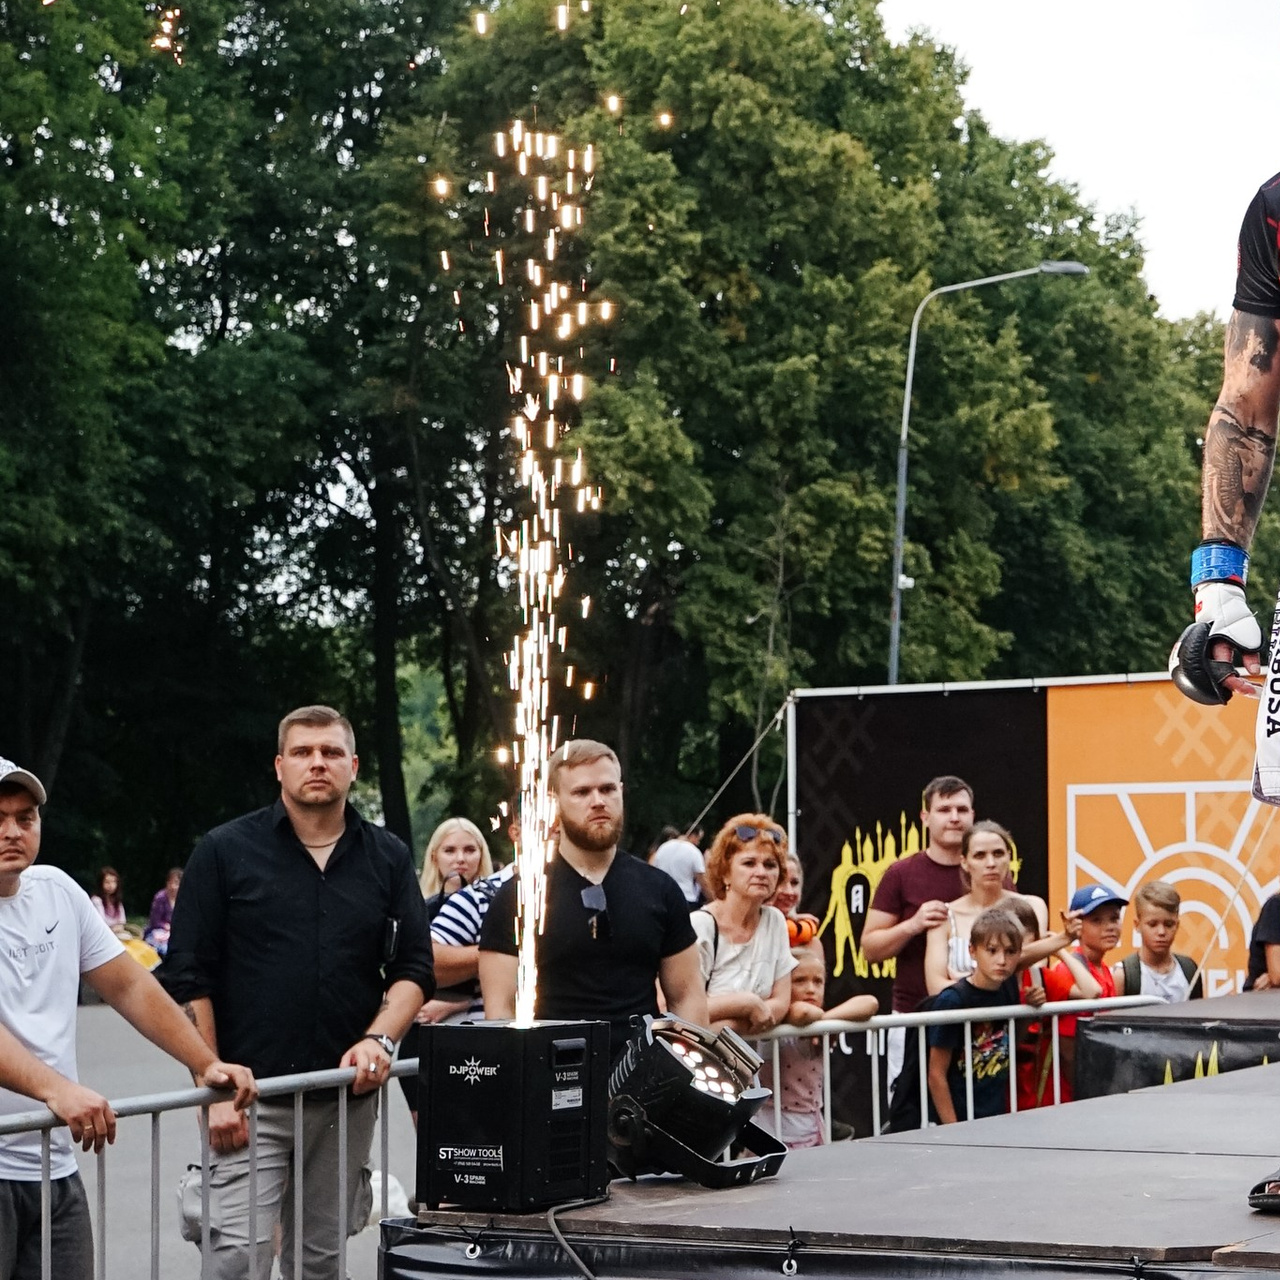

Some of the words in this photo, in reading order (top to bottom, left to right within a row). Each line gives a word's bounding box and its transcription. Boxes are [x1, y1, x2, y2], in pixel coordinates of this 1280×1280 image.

[555, 1072, 567, 1082] V-3
[438, 1147, 454, 1160] ST
[453, 1148, 476, 1157] SHOW
[478, 1148, 502, 1158] TOOLS
[454, 1173, 469, 1184] V-3
